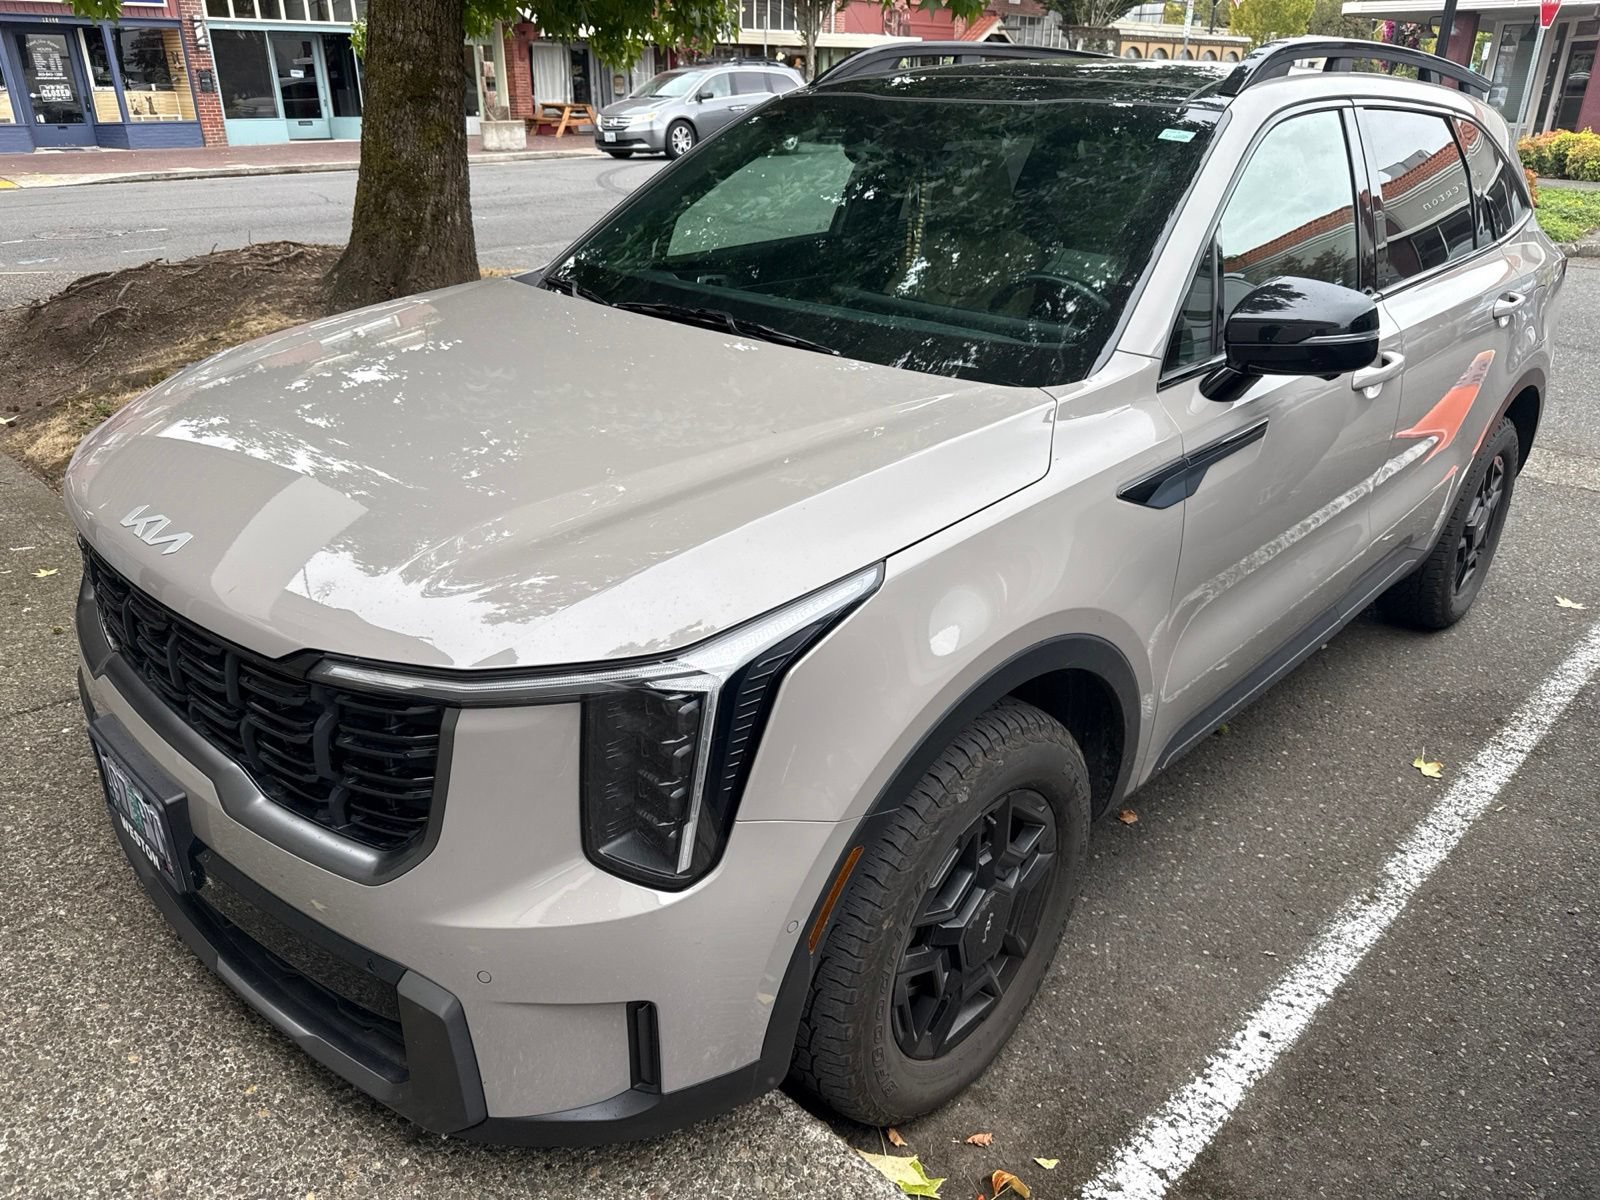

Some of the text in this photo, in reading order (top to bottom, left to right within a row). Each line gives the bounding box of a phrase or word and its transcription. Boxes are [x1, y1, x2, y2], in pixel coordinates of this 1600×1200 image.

[43, 89, 70, 97] CLOSED
[119, 504, 194, 556] KIA
[119, 812, 161, 871] WESTON
